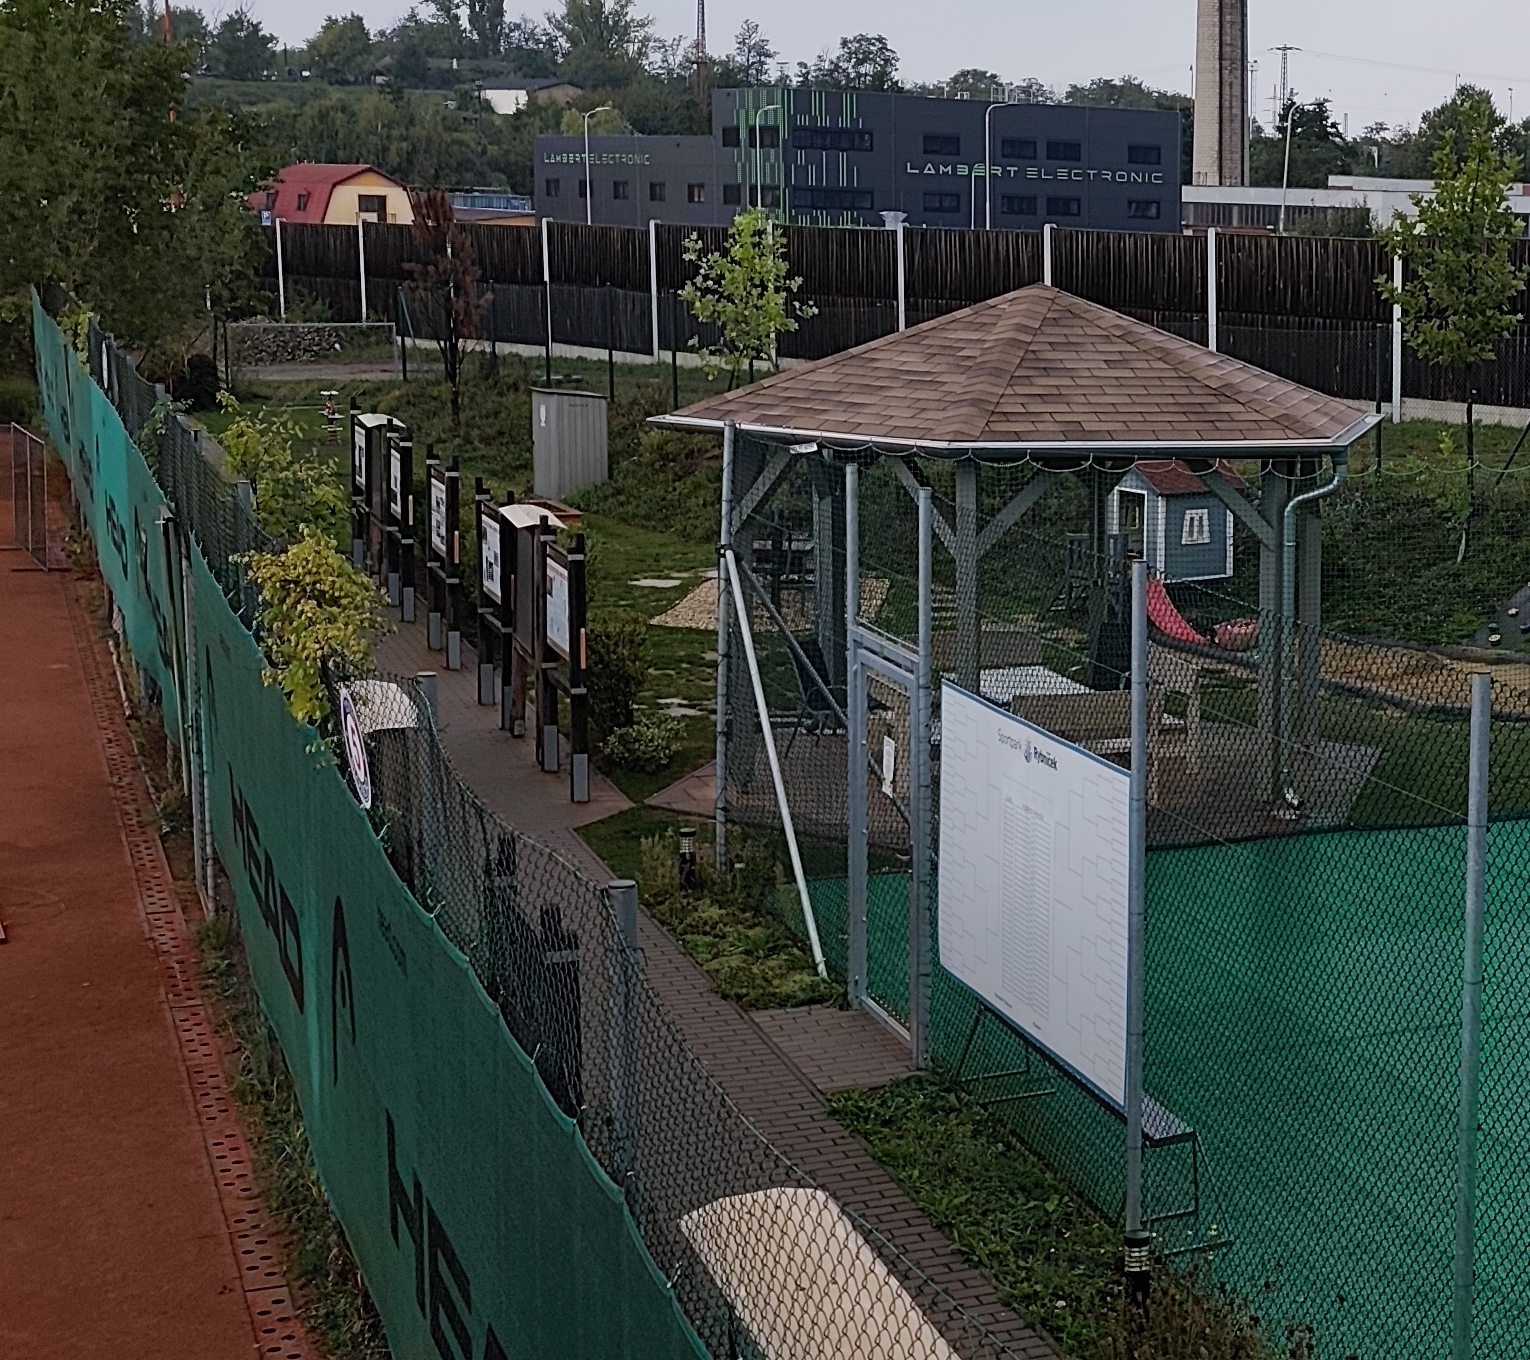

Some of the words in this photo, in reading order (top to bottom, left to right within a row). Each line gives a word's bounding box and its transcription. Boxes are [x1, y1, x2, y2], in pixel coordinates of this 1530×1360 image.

[543, 151, 588, 164] LAMBERT
[589, 153, 650, 165] ELECTRONIC
[906, 162, 1018, 178] LAMBERT
[1026, 167, 1163, 184] ELECTRONIC
[228, 760, 304, 1016] HEAD
